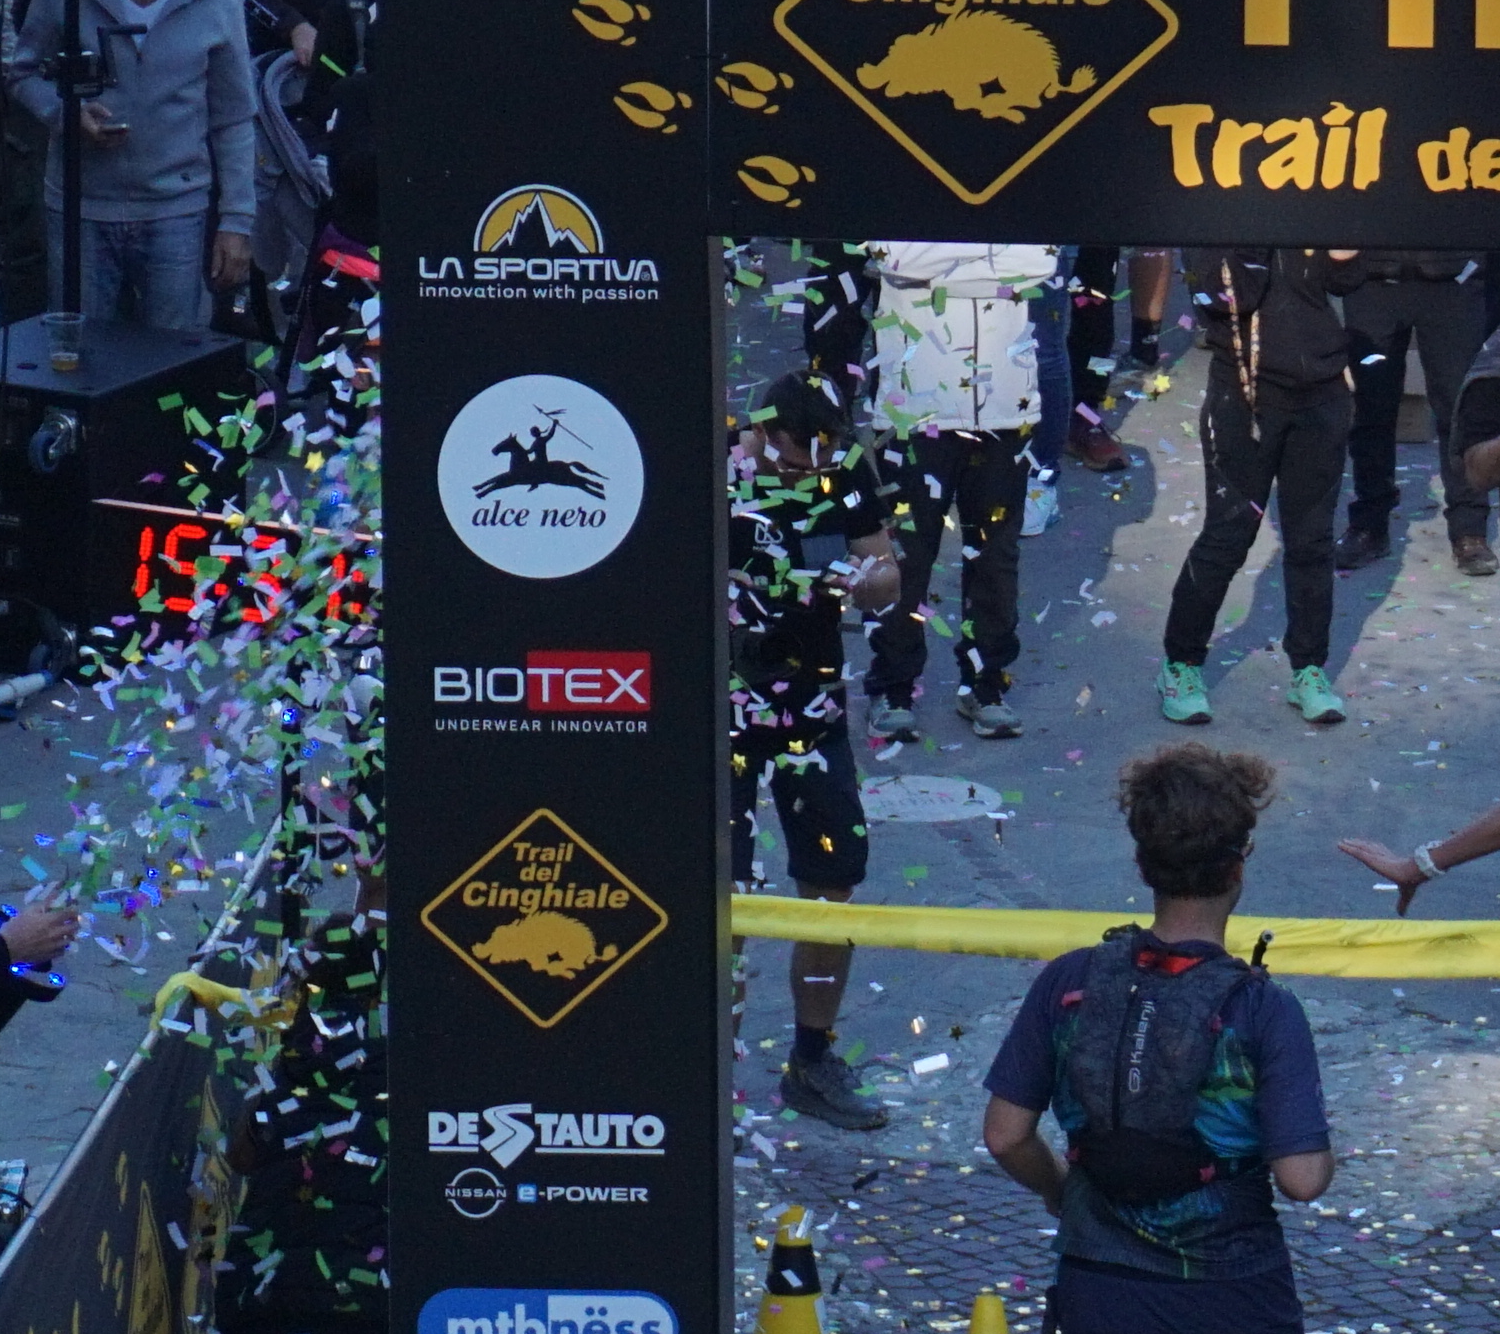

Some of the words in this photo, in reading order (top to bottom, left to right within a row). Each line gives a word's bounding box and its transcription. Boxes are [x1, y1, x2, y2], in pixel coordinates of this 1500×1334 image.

[1150, 103, 1386, 190] Trail
[420, 257, 463, 278] LA
[475, 257, 659, 283] SPORTIVA
[420, 284, 526, 298] innovation
[533, 285, 574, 298] with
[583, 286, 658, 303] passion
[471, 500, 533, 529] alce
[539, 505, 607, 529] nero
[433, 667, 649, 706] BIOTEX
[436, 719, 540, 731] UNDERWEAR
[552, 721, 646, 732] INNOVATOR
[511, 840, 575, 865] Trail
[519, 862, 561, 884] del
[462, 881, 630, 914] Cinghiale
[1130, 1000, 1156, 1065] Kalenji
[445, 1188, 507, 1199] NISSAN
[517, 1184, 649, 1204] e-POWER
